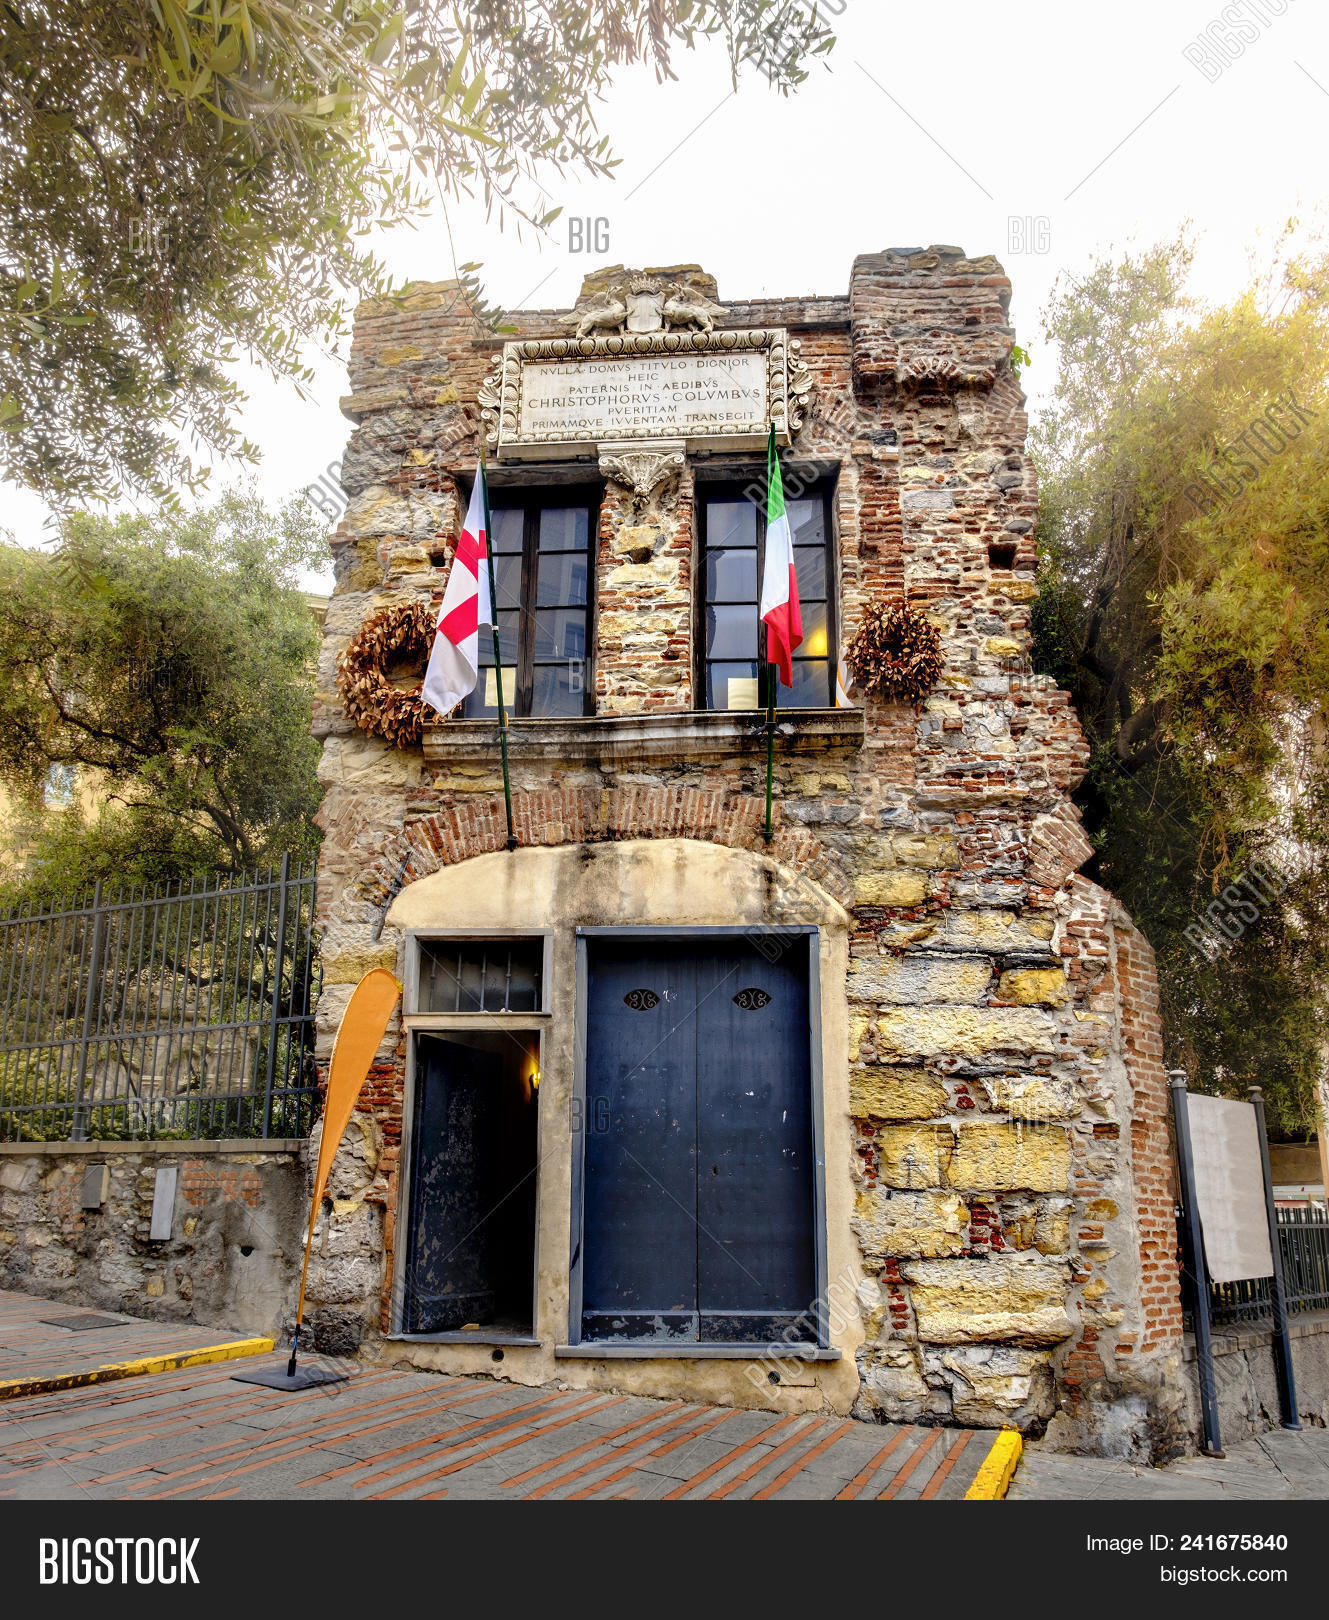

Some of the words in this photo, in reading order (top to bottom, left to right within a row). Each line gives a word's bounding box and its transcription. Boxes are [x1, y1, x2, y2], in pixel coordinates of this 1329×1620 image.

[540, 367, 582, 376] NVLLA
[589, 363, 631, 374] DOMVS
[640, 361, 687, 371] TITVLO
[628, 373, 660, 382] HEIC
[569, 384, 630, 395] PATERNIS
[640, 383, 652, 391] IN
[662, 380, 719, 390] AEDIBVS
[528, 393, 661, 409] CHRISTOPHORVS
[672, 389, 761, 401] COLVMBVS
[608, 405, 678, 415] PVERITIAM
[532, 418, 603, 429] PRIMAMQVE
[684, 411, 755, 422] TRANSEGIT
